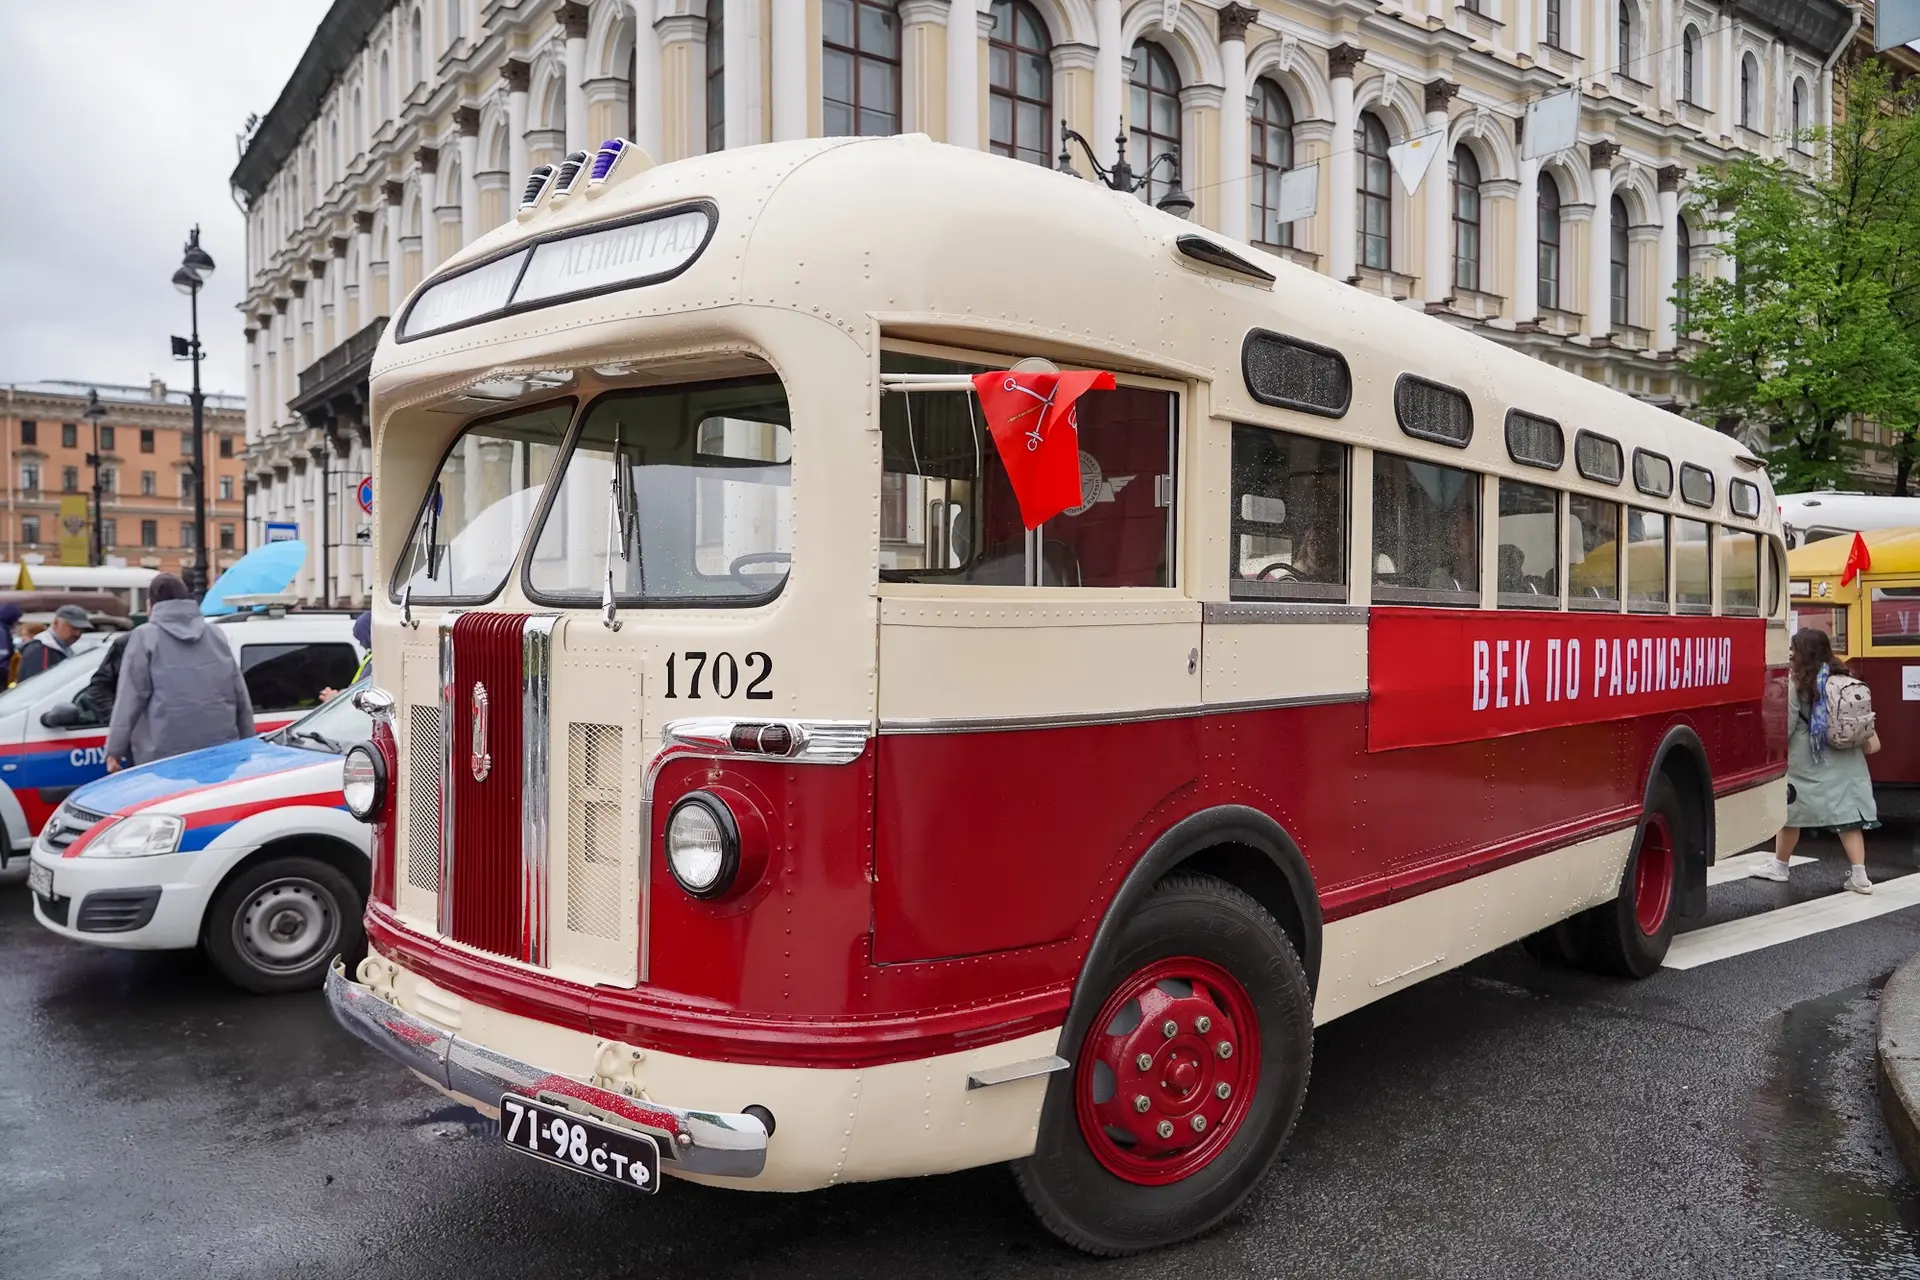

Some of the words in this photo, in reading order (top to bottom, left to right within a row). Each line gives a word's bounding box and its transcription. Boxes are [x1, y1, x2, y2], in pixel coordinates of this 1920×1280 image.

[664, 651, 774, 700] 1702
[1472, 639, 1531, 711] ВЕК
[1546, 638, 1581, 703] ПО
[1593, 637, 1732, 698] РАСПИСАНИЮ
[70, 747, 108, 767] СЛУ
